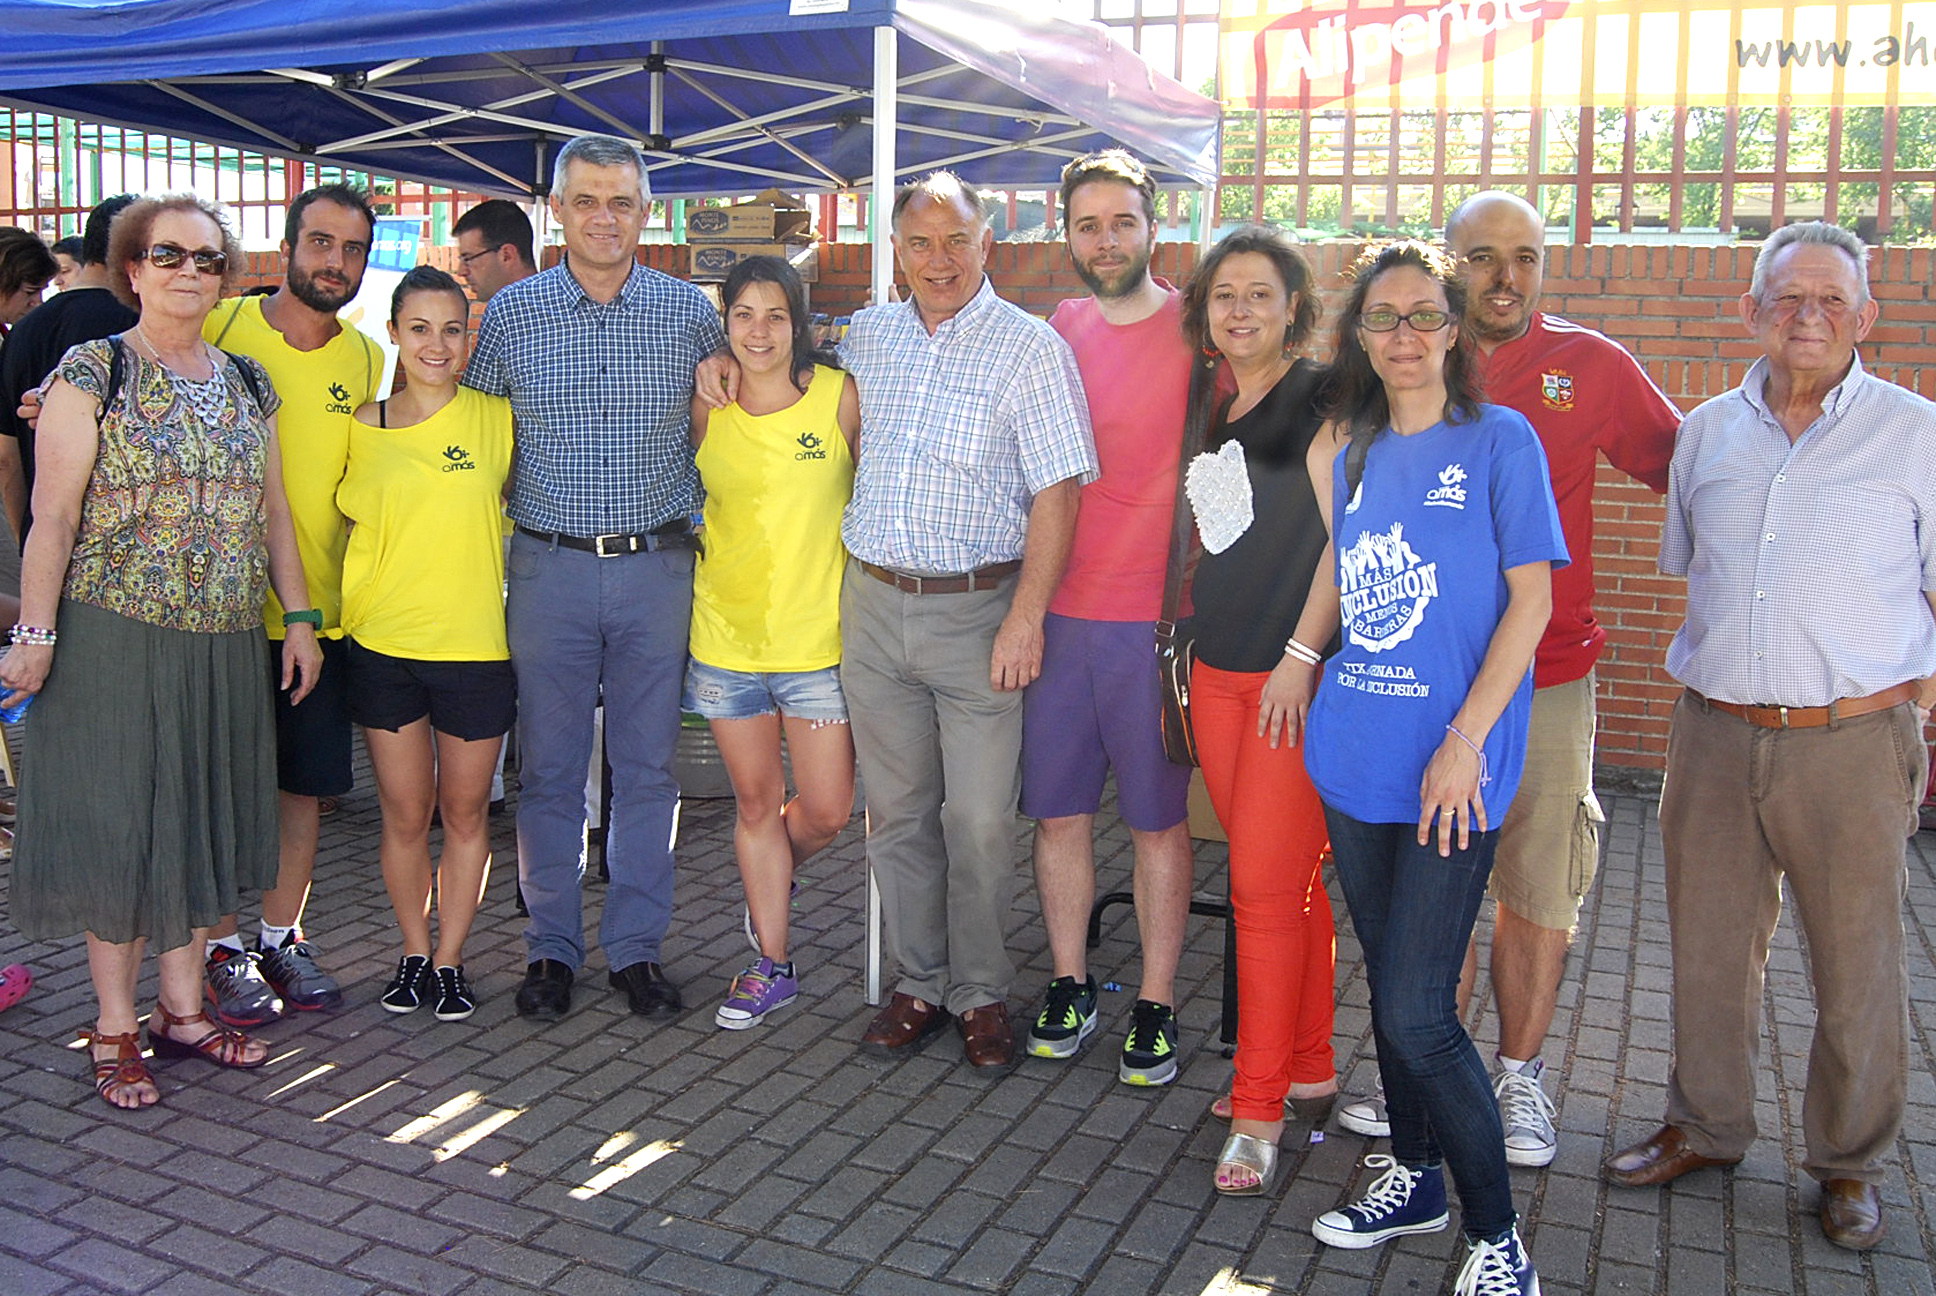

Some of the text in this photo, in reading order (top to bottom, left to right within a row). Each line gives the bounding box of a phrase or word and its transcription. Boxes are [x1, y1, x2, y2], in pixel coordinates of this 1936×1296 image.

[1735, 22, 1936, 68] www.ah
[1358, 567, 1393, 588] MÁS
[1337, 671, 1356, 688] POR
